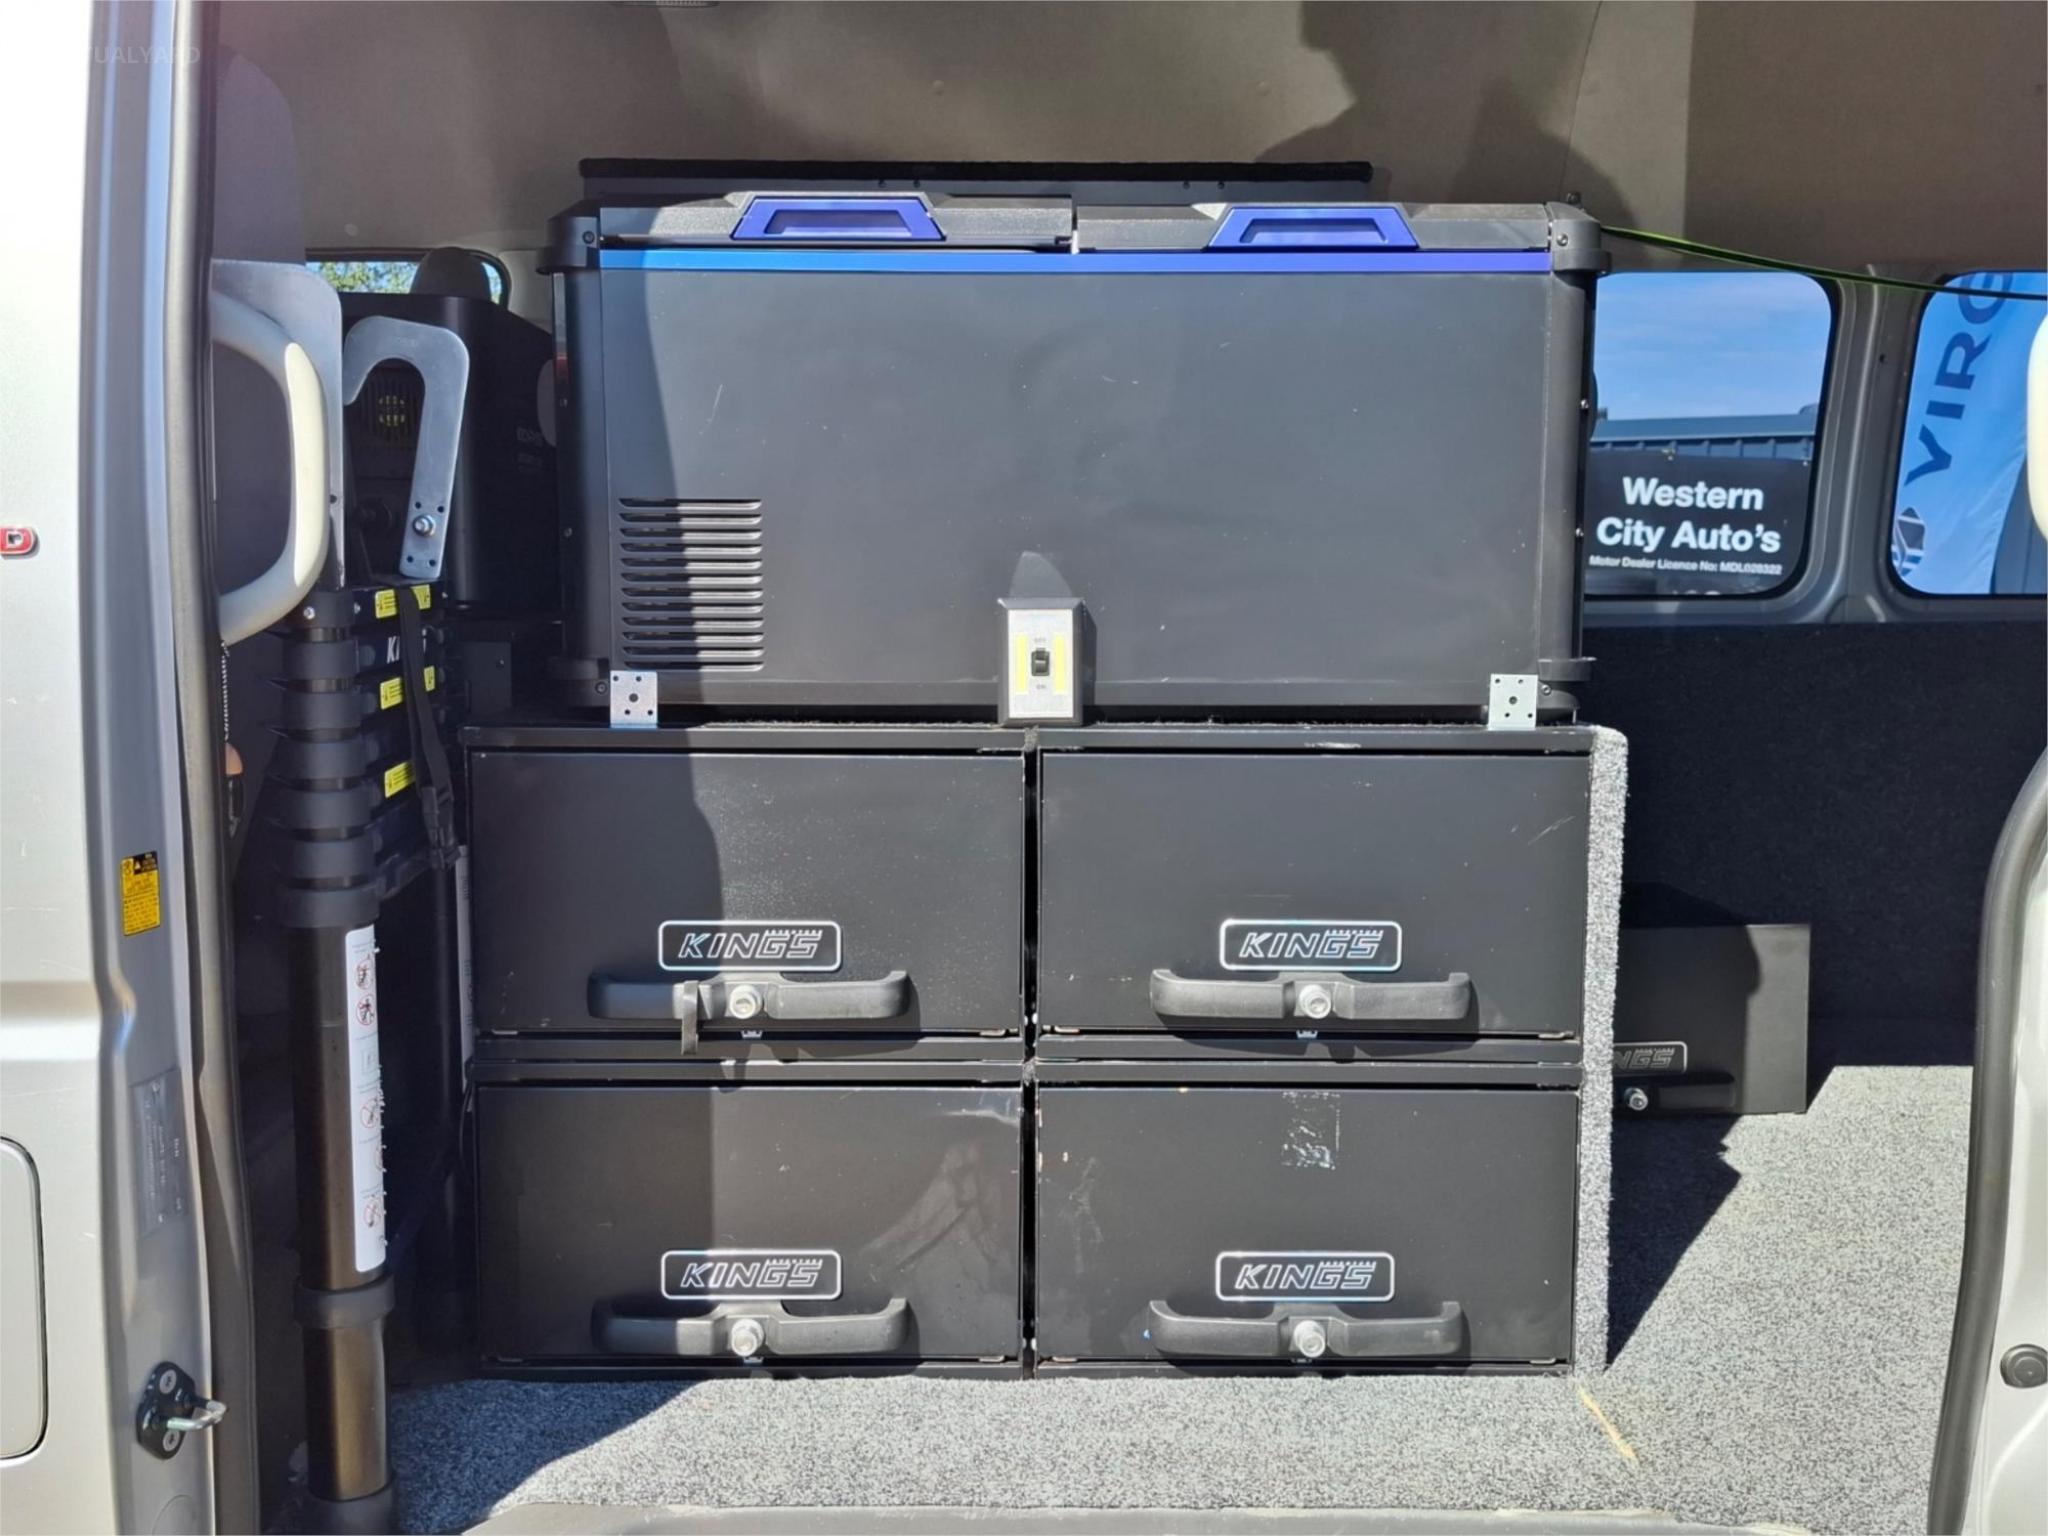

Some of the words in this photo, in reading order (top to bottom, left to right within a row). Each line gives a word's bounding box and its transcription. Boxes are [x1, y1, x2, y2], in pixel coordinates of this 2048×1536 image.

[1622, 476, 1764, 511] Western
[1596, 516, 1665, 553] City
[1671, 520, 1781, 553] Auto's
[1589, 555, 1620, 567] Motor
[1621, 556, 1656, 569] Dealer
[678, 929, 823, 959] KINGS
[1238, 929, 1384, 959] KINGS
[1613, 1047, 1675, 1069] NGS
[679, 1258, 824, 1289] KINGS
[1234, 1261, 1377, 1290] KINGS
